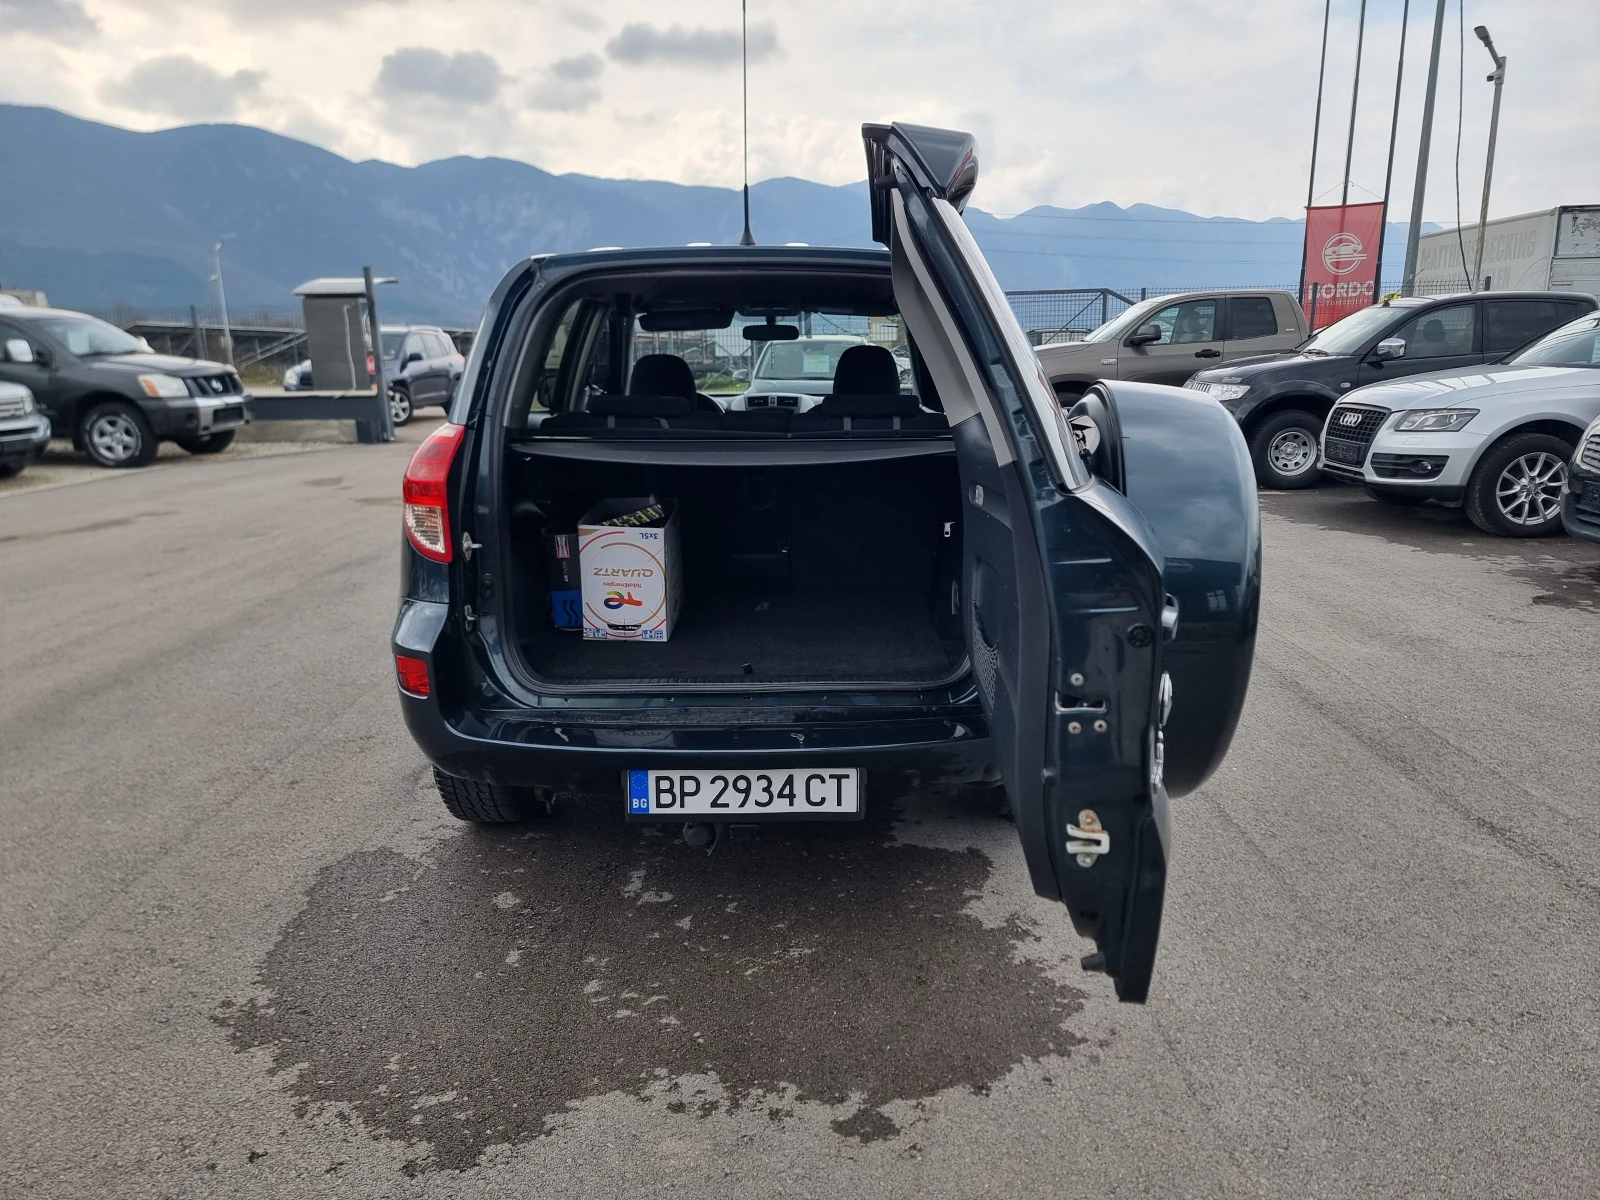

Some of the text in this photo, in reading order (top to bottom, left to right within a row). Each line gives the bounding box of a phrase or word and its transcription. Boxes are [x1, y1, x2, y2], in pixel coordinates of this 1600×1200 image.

[639, 532, 659, 540] 3x5L
[593, 567, 653, 578] QUARTZ
[603, 581, 643, 589] TotalEnergies
[655, 773, 850, 809] BP 2934 CT
[632, 798, 648, 809] BG
